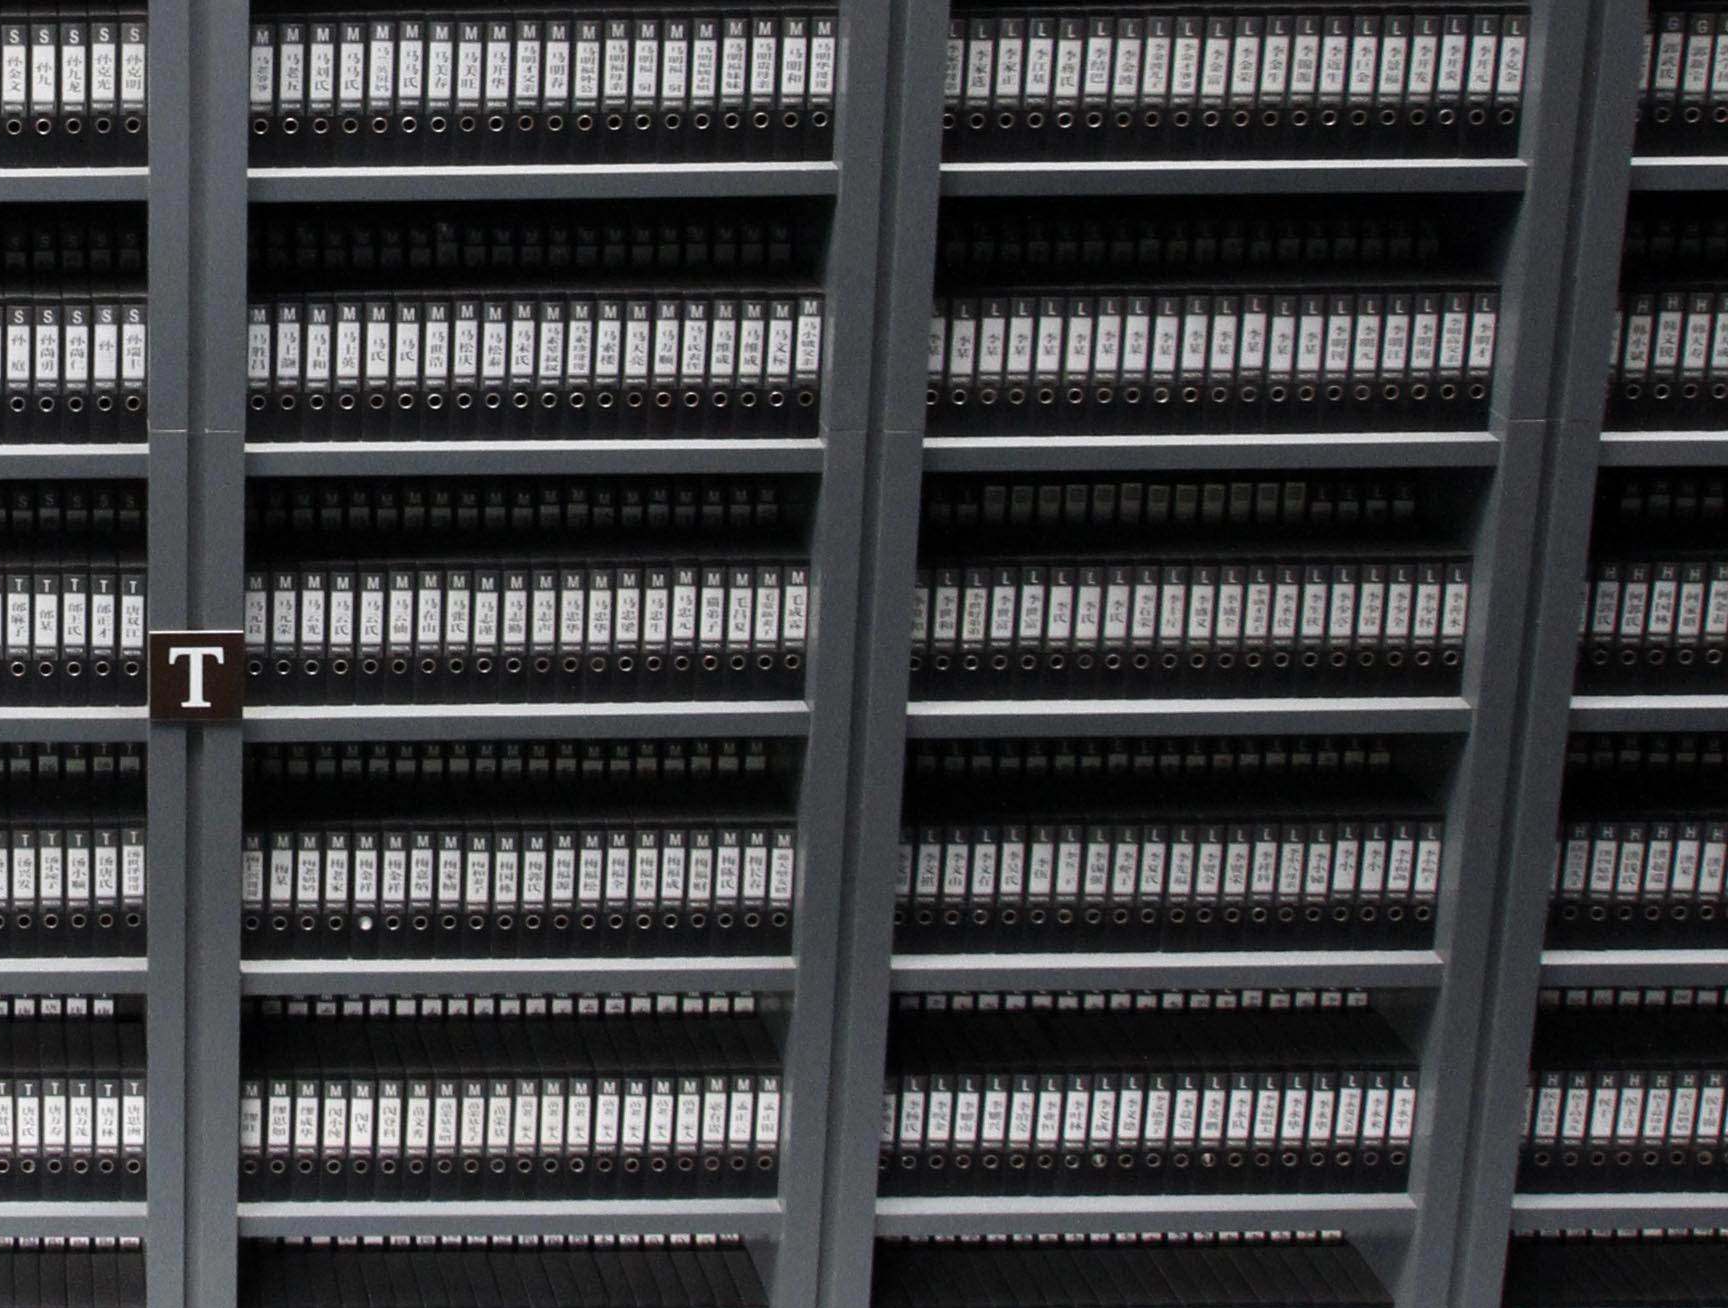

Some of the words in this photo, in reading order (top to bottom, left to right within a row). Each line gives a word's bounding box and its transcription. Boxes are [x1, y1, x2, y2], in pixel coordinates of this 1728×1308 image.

[789, 22, 802, 35] M
[1276, 16, 1284, 31] L
[39, 29, 49, 44] S
[99, 27, 109, 42] S
[130, 27, 139, 42] S
[286, 28, 299, 42] M
[317, 28, 329, 41] M
[347, 27, 359, 41] M
[406, 24, 418, 38] M
[313, 309, 326, 323] M
[343, 307, 356, 320] M
[373, 307, 385, 320] M
[403, 308, 415, 321] M
[461, 305, 473, 318] M
[489, 307, 501, 320] M
[518, 305, 531, 318] M
[991, 303, 1000, 316] L
[72, 310, 82, 324] S
[371, 338, 386, 362] 马氏
[400, 339, 415, 362] 马氏
[280, 576, 291, 589] M
[308, 576, 320, 588] M
[337, 577, 349, 590] M
[367, 576, 379, 589] M
[396, 576, 408, 588] M
[425, 575, 437, 588] M
[453, 575, 465, 588] M
[680, 571, 692, 584] M
[1087, 572, 1096, 585] L
[1115, 571, 1124, 584] L
[43, 579, 51, 592] T
[169, 647, 223, 707] T
[102, 832, 109, 845] T
[332, 836, 344, 848] M
[1040, 829, 1048, 842] L
[1022, 1079, 1030, 1092] L
[1710, 1075, 1720, 1085] H
[330, 1085, 342, 1097] M
